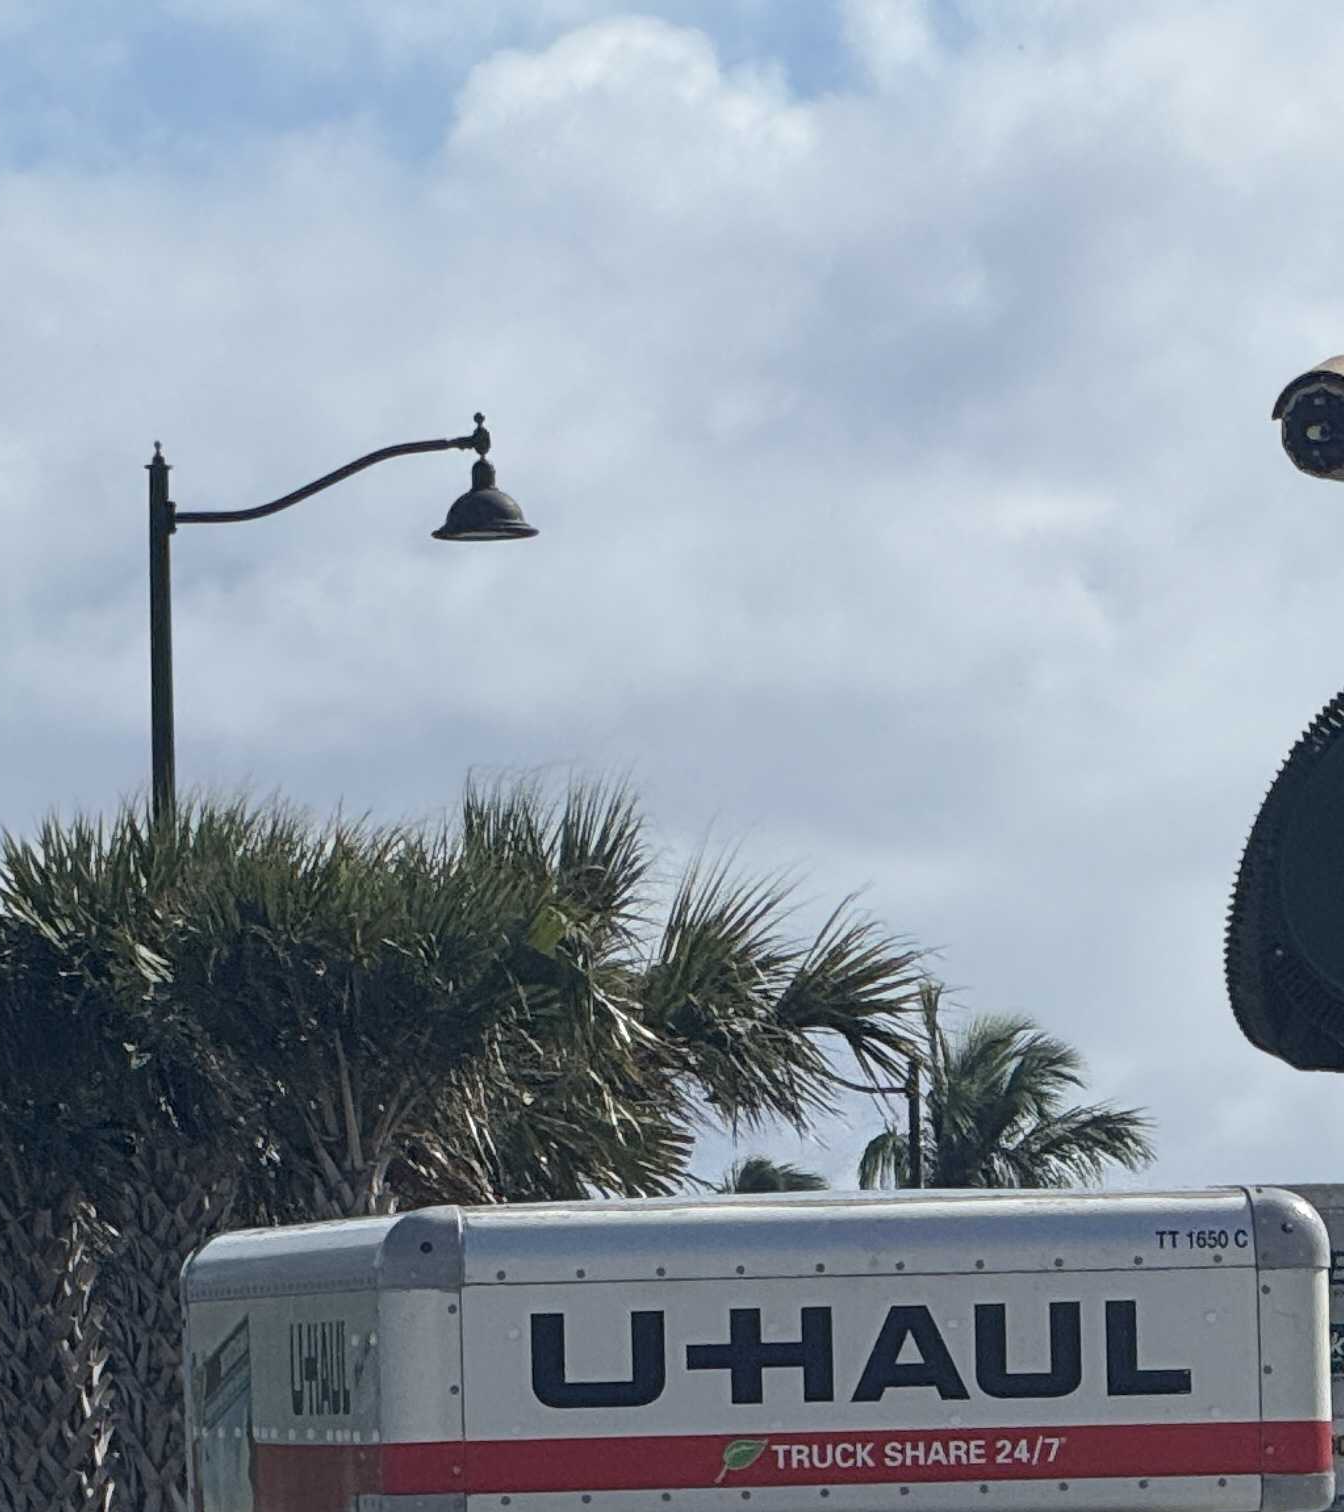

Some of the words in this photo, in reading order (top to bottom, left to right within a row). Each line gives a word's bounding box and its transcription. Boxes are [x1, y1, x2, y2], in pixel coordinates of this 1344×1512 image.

[1155, 1230, 1180, 1250] TT
[1186, 1229, 1229, 1250] 1650
[1234, 1228, 1249, 1249] C
[289, 1319, 351, 1416] U-HAUL
[530, 1299, 1192, 1409] U-HAUL
[770, 1442, 875, 1470] TRUCK
[883, 1439, 986, 1468] SHARE
[995, 1435, 1061, 1466] 24/7
